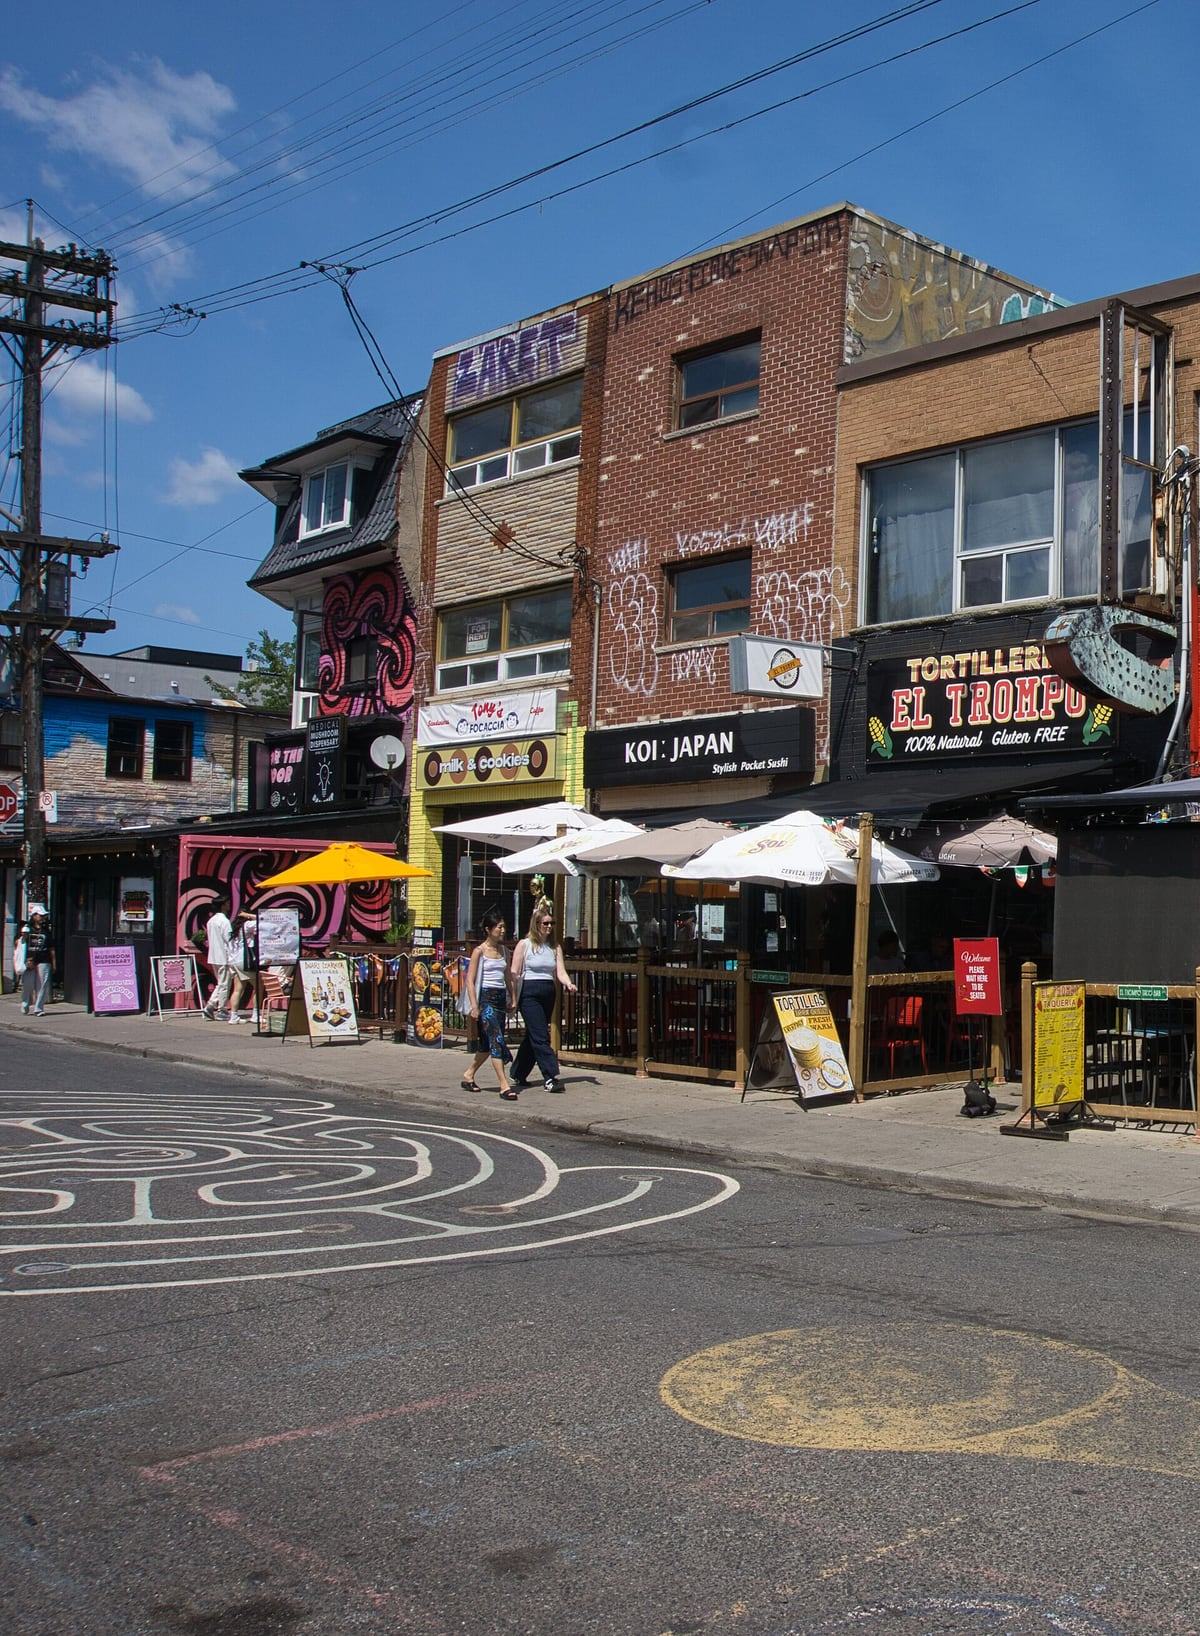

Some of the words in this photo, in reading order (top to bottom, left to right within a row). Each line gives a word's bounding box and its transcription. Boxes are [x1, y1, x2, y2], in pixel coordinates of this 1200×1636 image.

[471, 624, 486, 633] FOR
[469, 632, 488, 641] RENT
[907, 645, 1052, 683] TORTILLERI
[890, 686, 933, 732] EL
[946, 675, 1087, 727] TROMPO
[471, 701, 504, 721] Tony's
[311, 721, 339, 731] MEDICAL
[469, 720, 505, 734] FOCACCIA
[310, 729, 339, 739] MUSHROOM
[904, 735, 936, 752] 100%
[937, 731, 983, 750] Natural
[992, 731, 1031, 746] Gluten
[1034, 726, 1069, 743] FREE
[310, 738, 339, 748] DISPENSARY
[670, 731, 734, 763] JAPAN
[439, 758, 464, 774] milk
[467, 760, 476, 770] &
[479, 752, 530, 770] cookies
[712, 763, 737, 774] Stylish
[740, 759, 765, 772] Pocket
[767, 757, 789, 769] Sushi
[938, 853, 957, 861] LIGHT
[781, 868, 806, 877] CERVEZA
[961, 951, 992, 964] Welcome
[968, 965, 985, 974] PLEASE
[965, 974, 976, 983] WAIT
[977, 974, 988, 983] HERE
[971, 983, 978, 991] TO
[978, 983, 984, 991] BE
[969, 992, 986, 1000] SEATED
[776, 993, 826, 1012] TORTILLAS
[1043, 1000, 1077, 1008] TAQUERIA
[808, 1016, 832, 1024] FRESH
[810, 1023, 833, 1031] WARM
